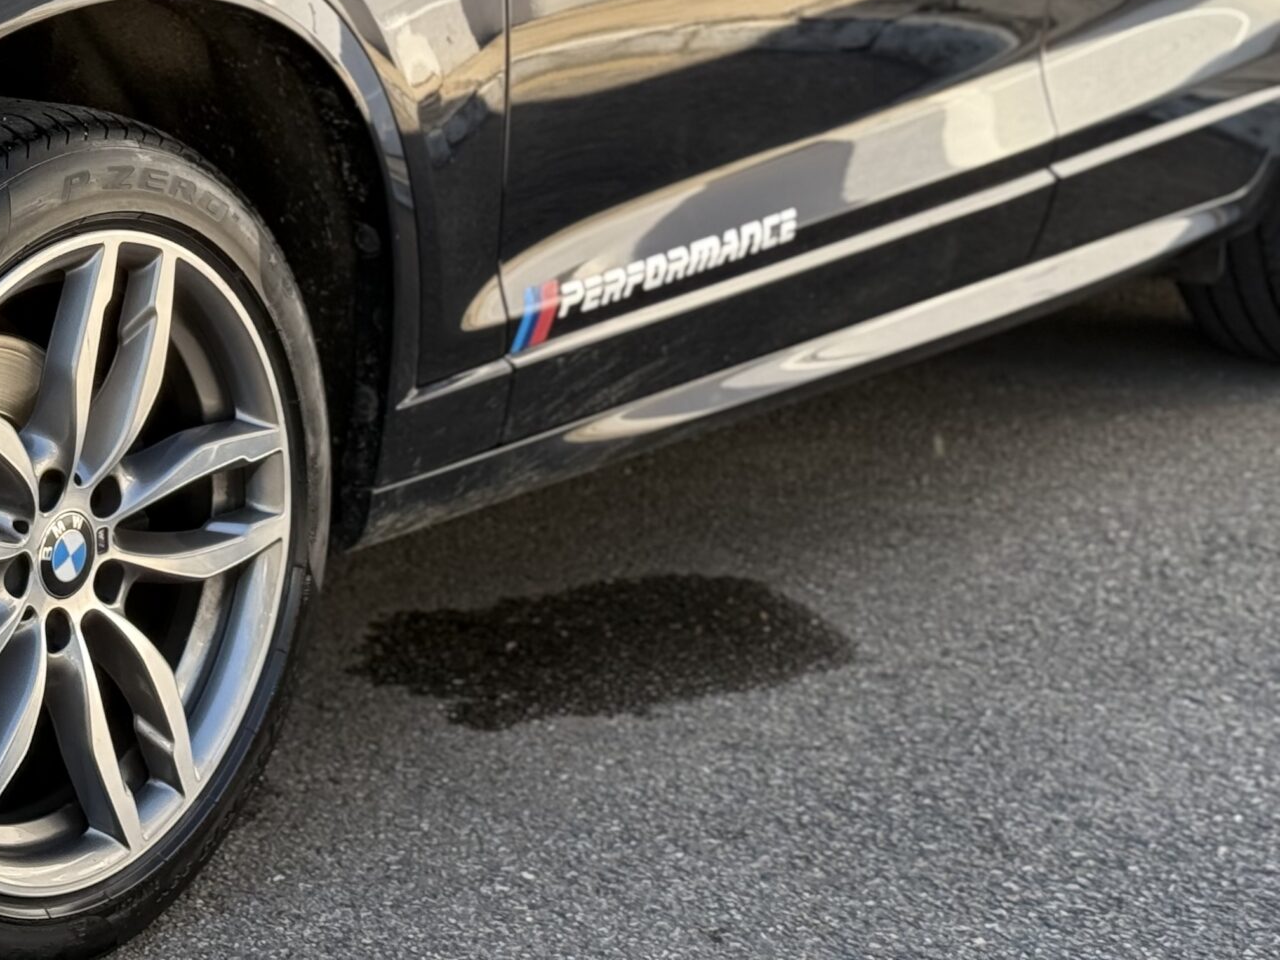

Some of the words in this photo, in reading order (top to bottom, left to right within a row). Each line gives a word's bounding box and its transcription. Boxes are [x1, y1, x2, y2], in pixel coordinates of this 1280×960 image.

[102, 164, 232, 222] ZERO
[557, 206, 799, 320] PERFORMANCE
[42, 514, 85, 561] BMW
